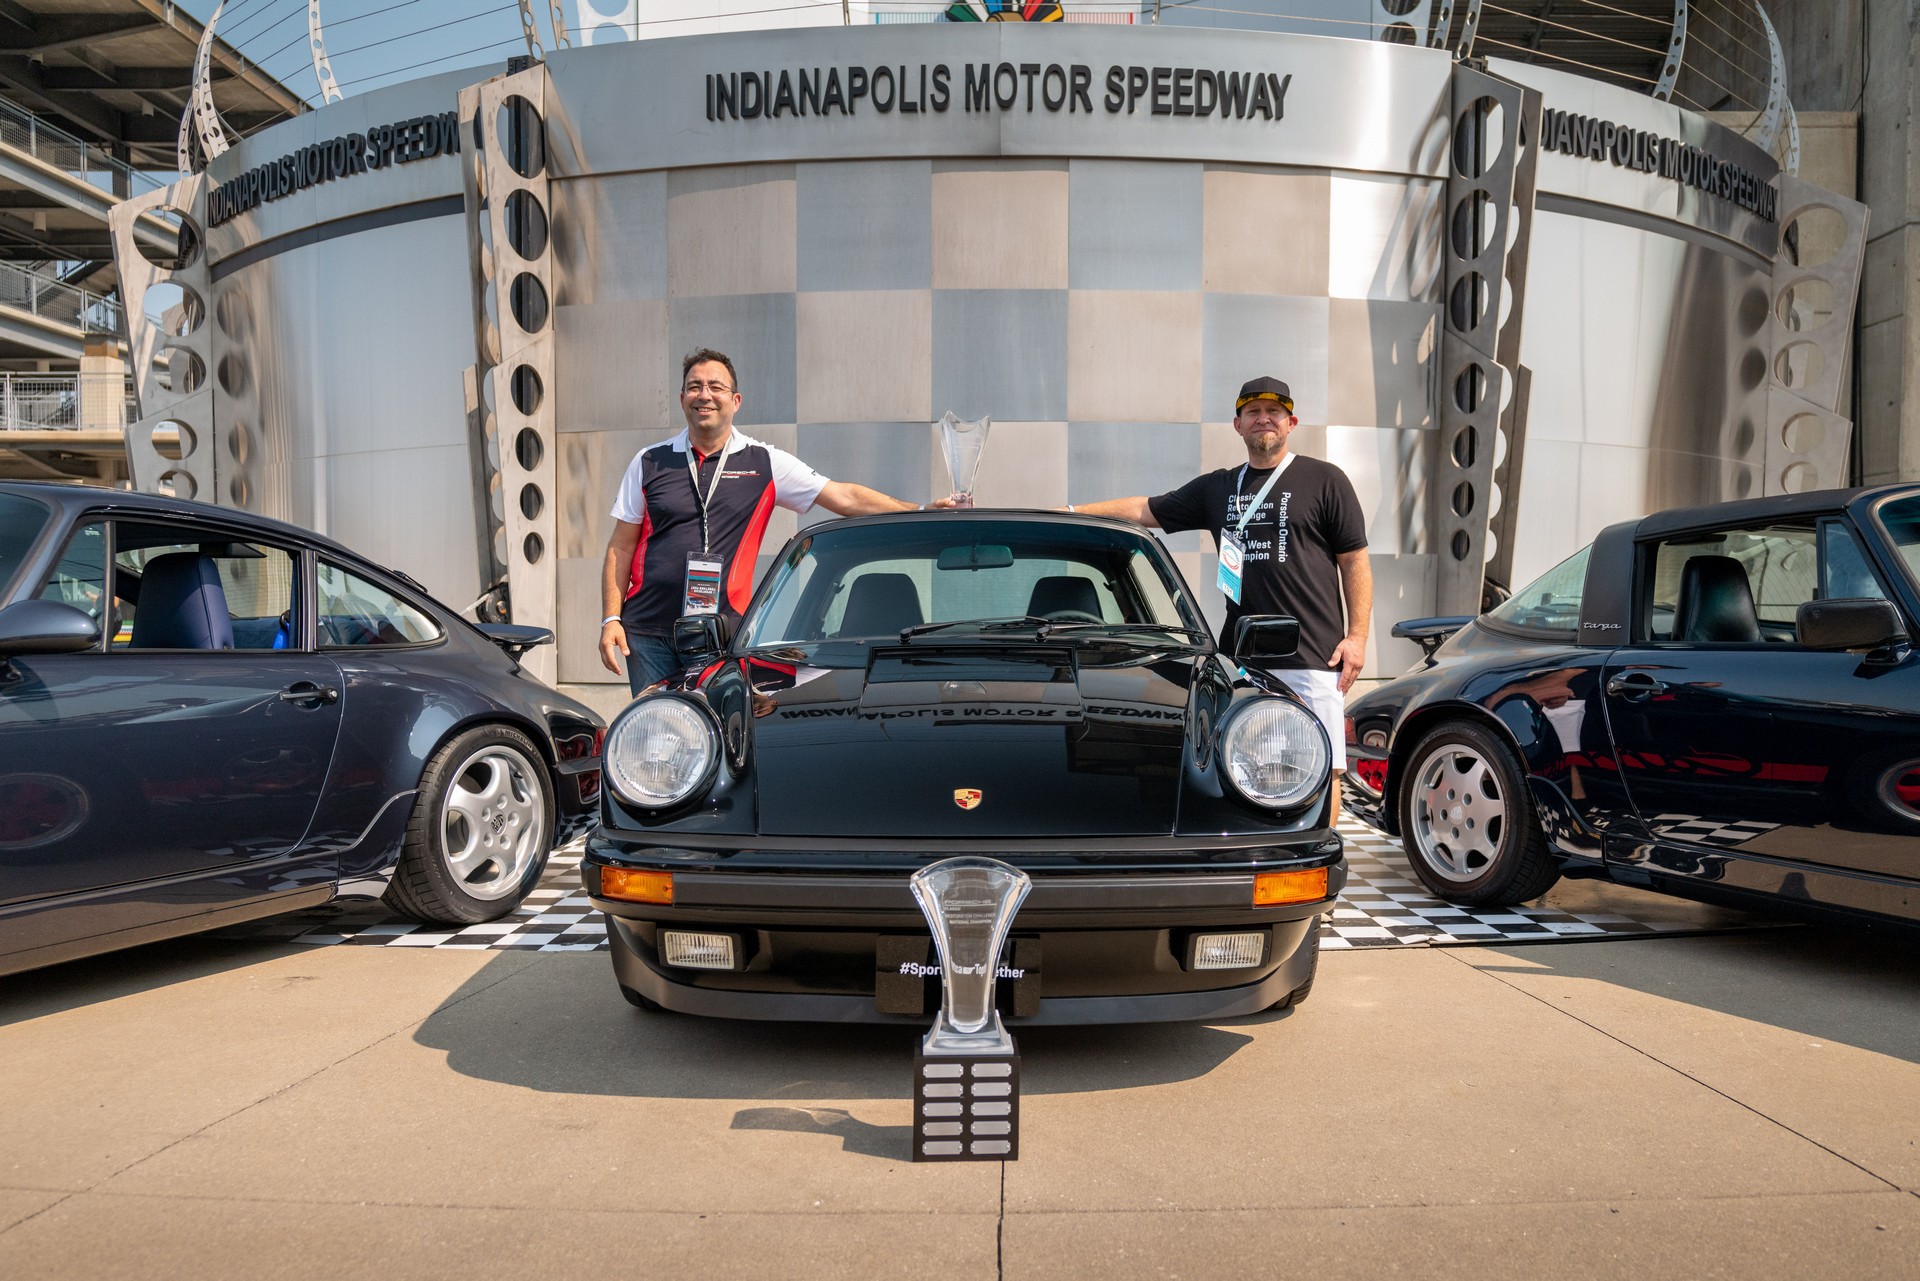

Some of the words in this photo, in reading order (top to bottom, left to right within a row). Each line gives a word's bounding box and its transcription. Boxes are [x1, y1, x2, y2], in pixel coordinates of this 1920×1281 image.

[706, 64, 951, 121] INDIANAPOLIS
[965, 62, 1093, 113] MOTOR
[1104, 65, 1292, 120] SPEEDWAY
[208, 154, 297, 228] NDIANAPOLIS
[294, 132, 368, 189] MOTOR
[366, 111, 460, 169] SPEEDW
[1659, 138, 1722, 195] MOTOR
[1229, 493, 1257, 503] Clssic
[1279, 491, 1292, 527] Porsche
[1247, 540, 1272, 550] West
[1278, 528, 1289, 563] Ontario
[1583, 621, 1622, 631] targa
